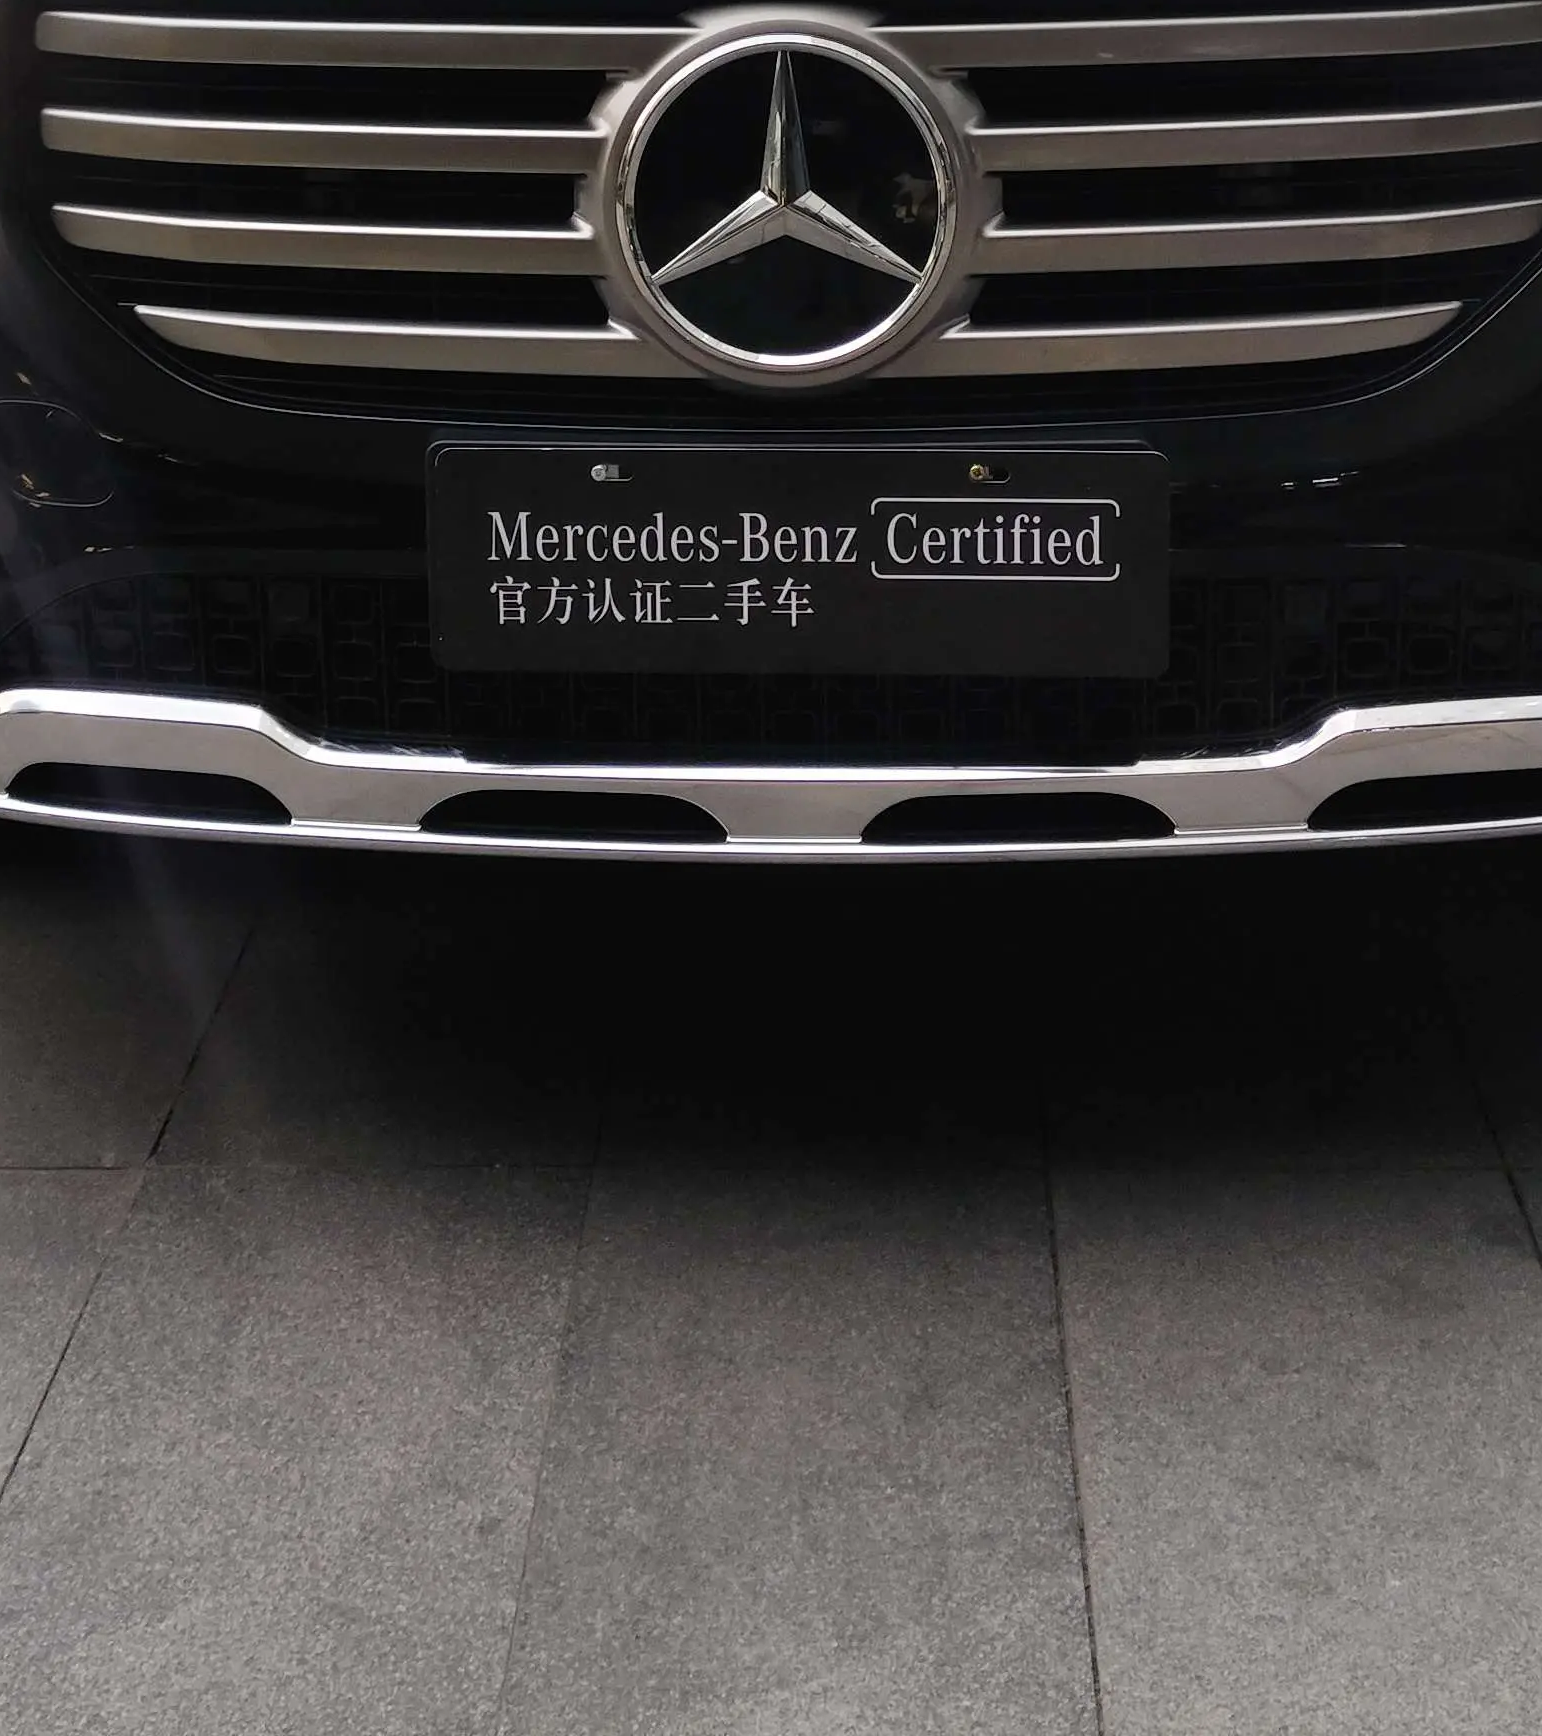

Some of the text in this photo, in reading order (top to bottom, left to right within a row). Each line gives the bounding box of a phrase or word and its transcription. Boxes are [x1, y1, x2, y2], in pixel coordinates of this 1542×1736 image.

[487, 511, 1104, 566] Mercedes-Benz Certified
[489, 575, 815, 628] 官方认证二手车
